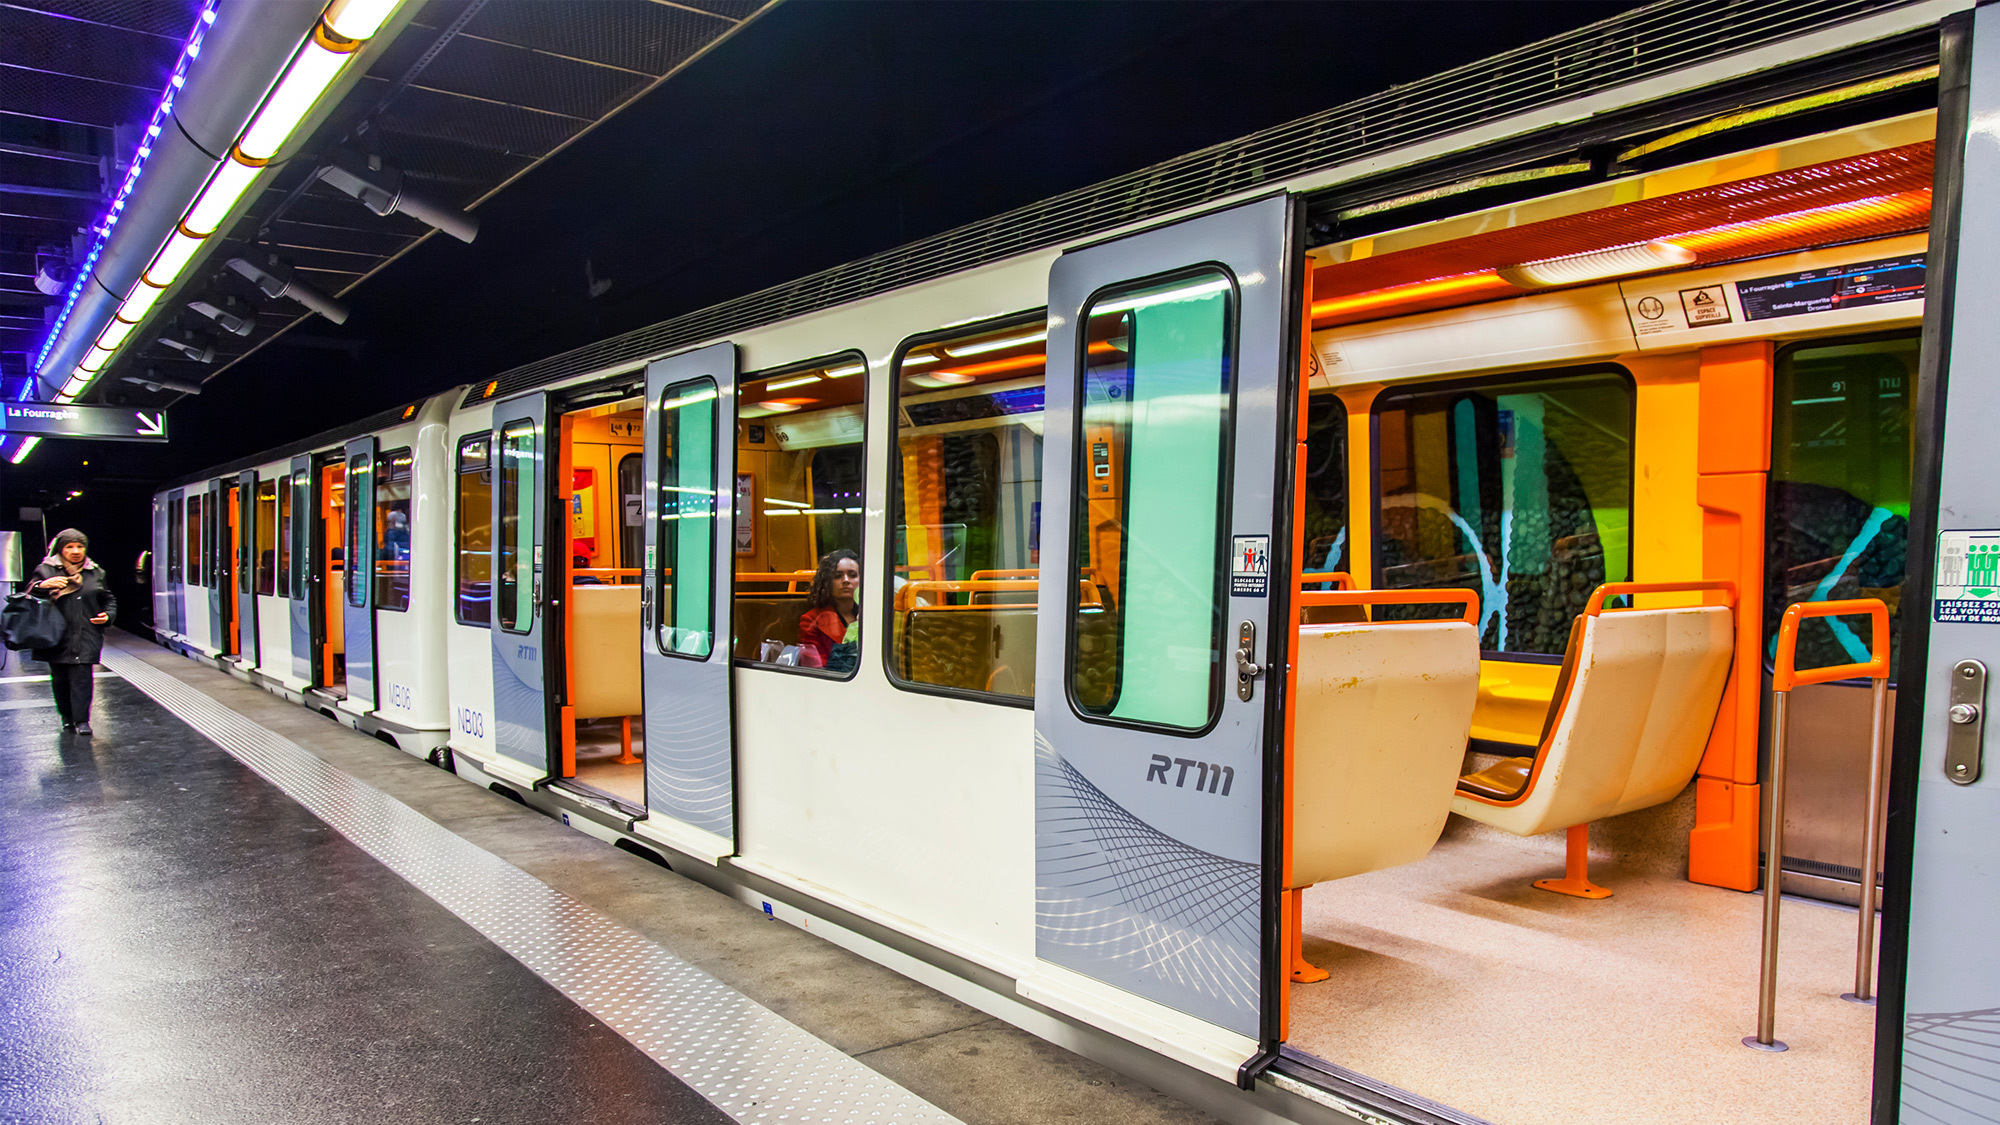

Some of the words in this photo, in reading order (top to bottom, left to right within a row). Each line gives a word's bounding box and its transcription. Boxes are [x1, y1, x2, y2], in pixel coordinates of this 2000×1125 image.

[1750, 283, 1785, 292] Fourragère
[1772, 297, 1830, 310] Sainte-Marguerite
[1808, 304, 1832, 312] Dromel
[7, 407, 22, 417] La
[22, 407, 80, 420] Fourragère
[458, 706, 484, 739] NB03
